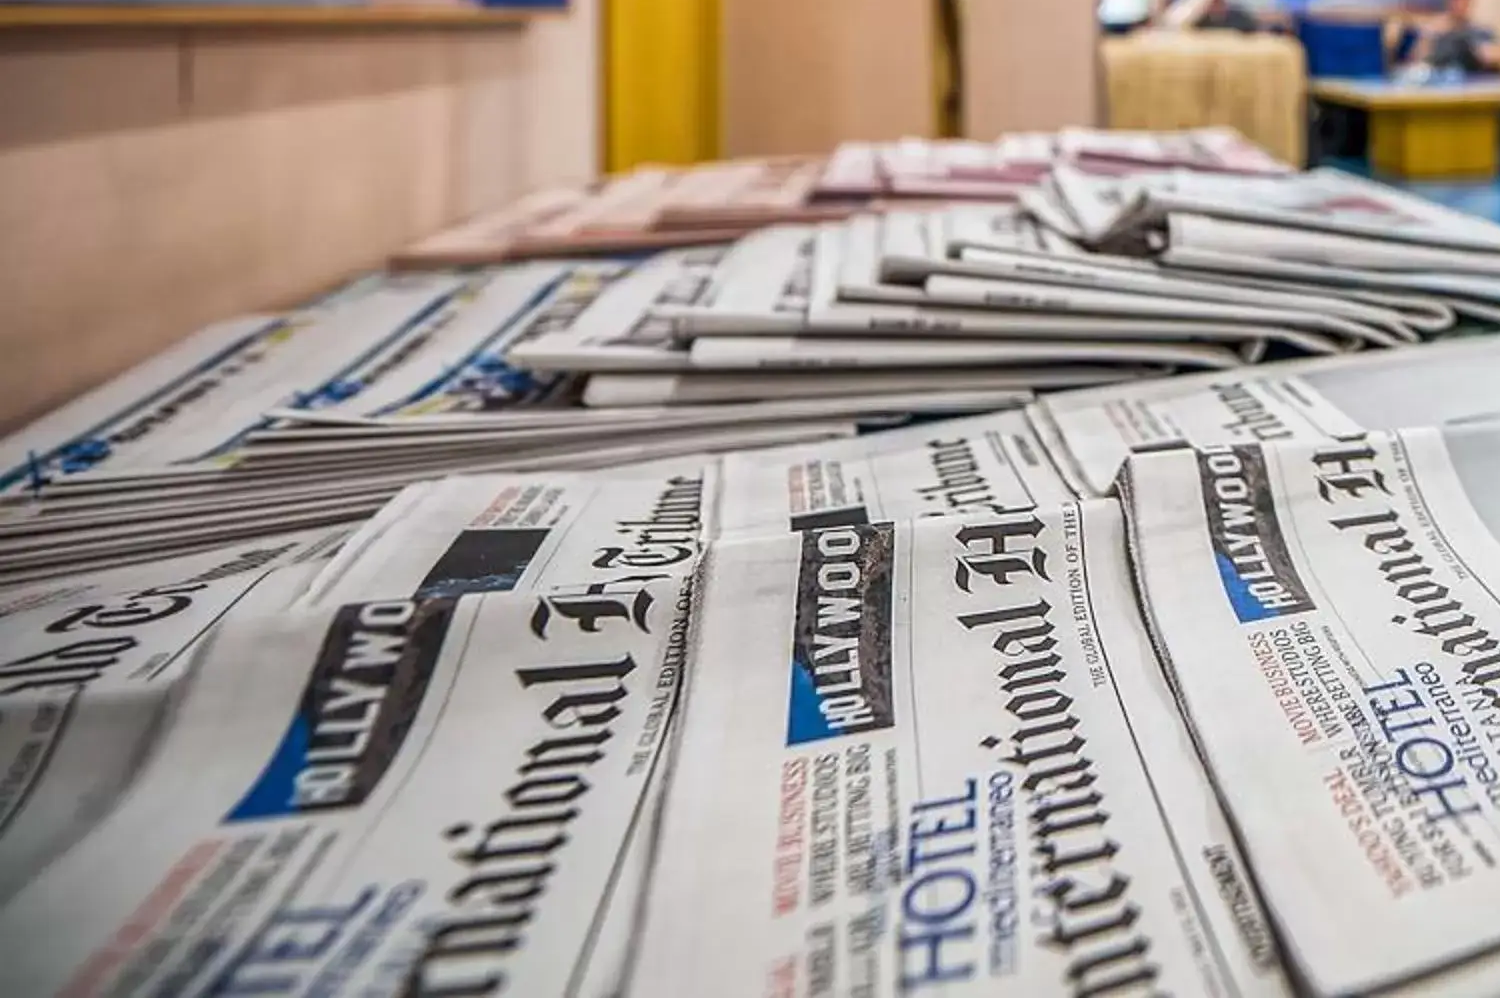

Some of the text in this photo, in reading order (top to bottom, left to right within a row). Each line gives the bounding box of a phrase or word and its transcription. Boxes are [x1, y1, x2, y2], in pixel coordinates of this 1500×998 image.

[812, 524, 876, 730] HOLLYWOO
[1064, 509, 1107, 689] THE GLOBAL EDITION OF THE
[1291, 621, 1316, 645] BIG
[657, 618, 687, 689] EDITION
[1248, 631, 1321, 746] MOVIE BUSINESS
[1270, 629, 1315, 687] STUDIOS
[1303, 646, 1350, 701] BETTING
[1302, 687, 1345, 739] WHERE
[1363, 668, 1482, 824] HOTEL
[811, 753, 840, 838] STUDIOS
[846, 743, 871, 775] BIG
[955, 596, 1162, 998] nternational
[778, 757, 809, 853] BUSINESS
[846, 775, 872, 855] BETTING
[898, 777, 978, 989] HOTEL
